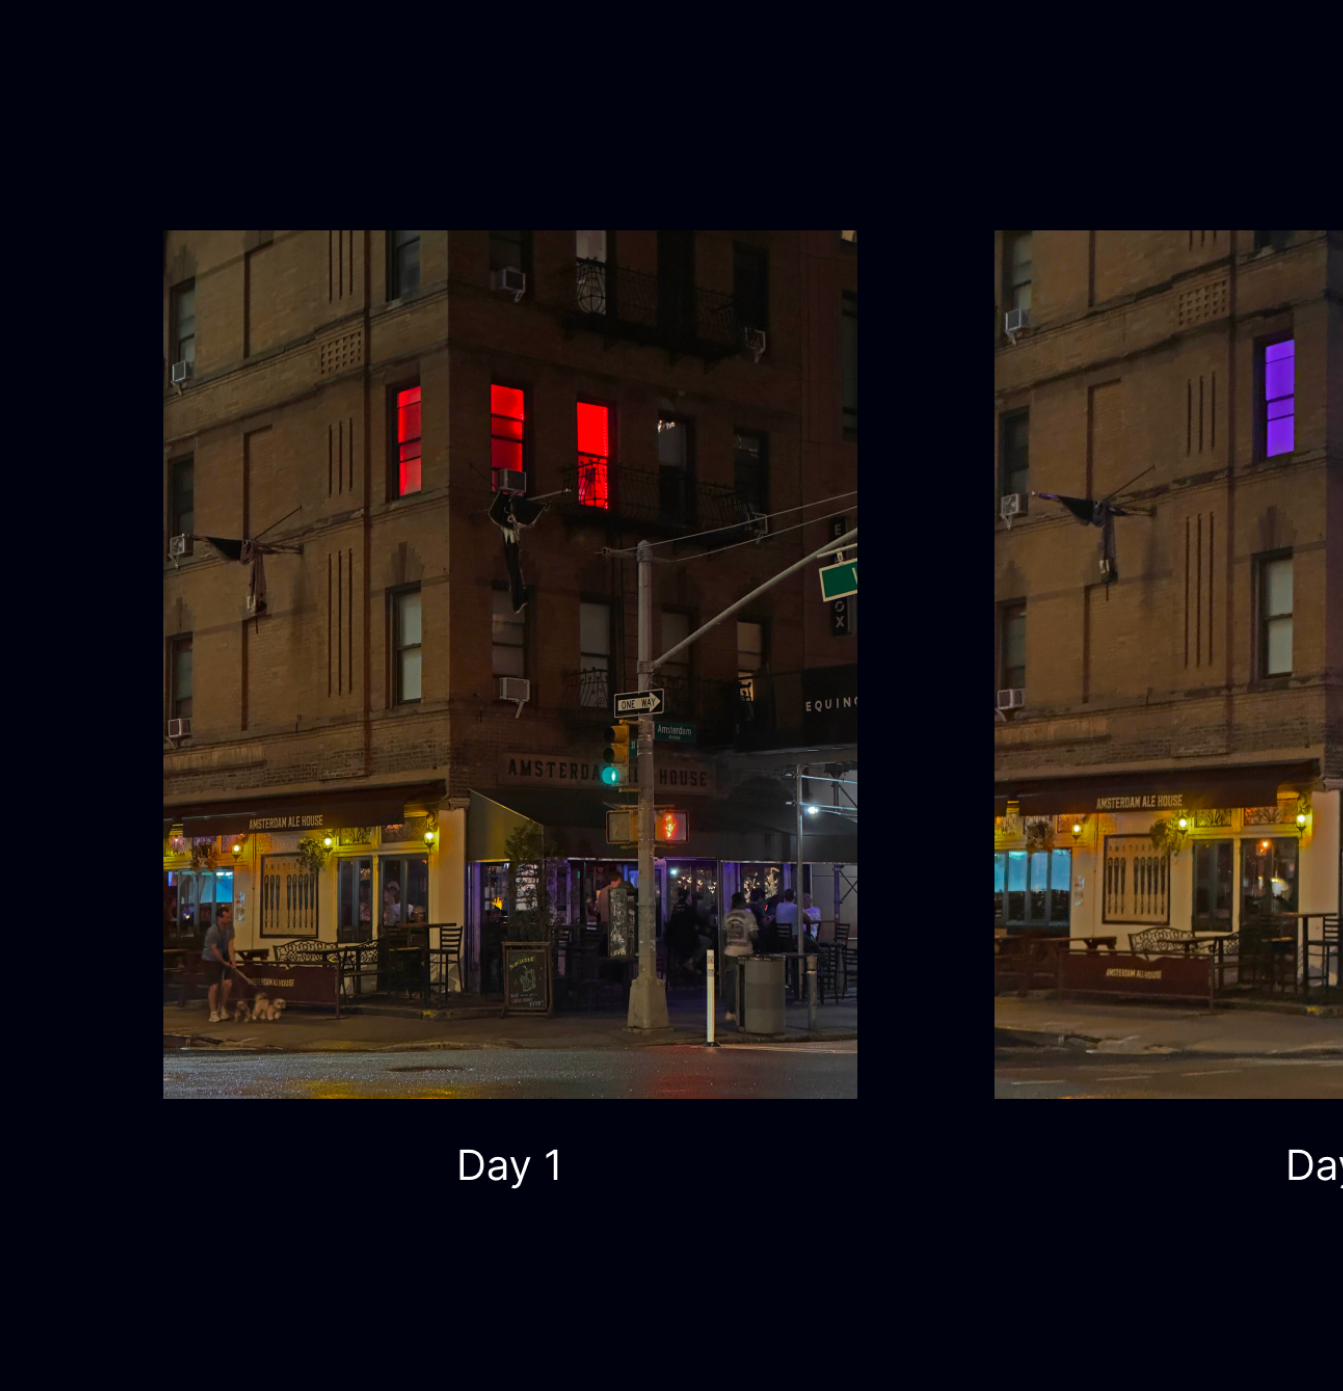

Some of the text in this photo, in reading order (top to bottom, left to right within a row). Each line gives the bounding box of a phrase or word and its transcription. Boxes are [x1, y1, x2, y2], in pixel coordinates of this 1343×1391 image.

[621, 697, 656, 710] ONE WAY
[657, 724, 692, 736] Amsterdam
[508, 758, 602, 781] AMSTERDA
[659, 768, 708, 787] HOUSE
[1096, 793, 1183, 810] AMSTERDAM ALE HOUSE
[248, 814, 324, 830] AMSTERDAM ALE HOUSE
